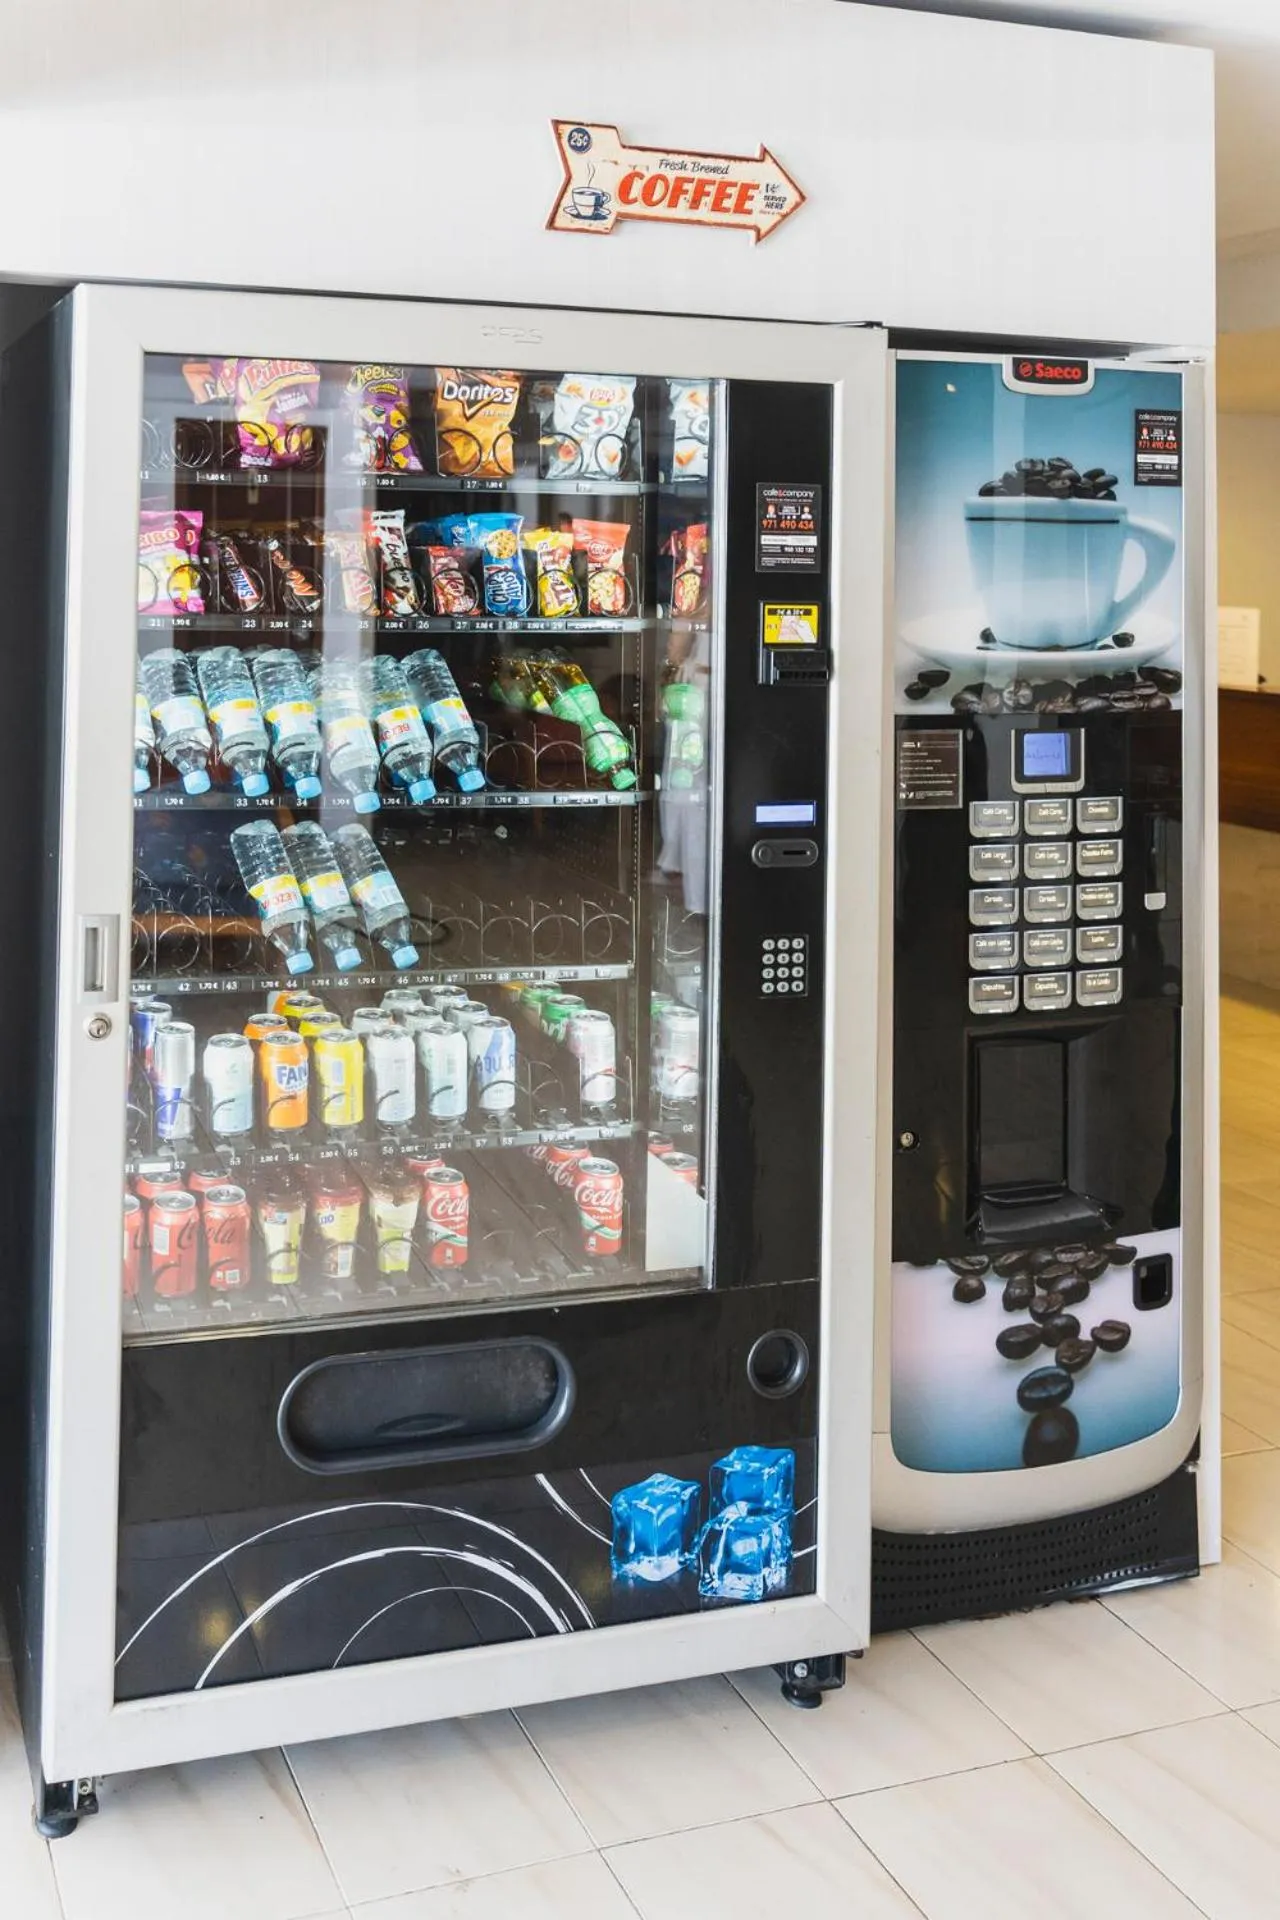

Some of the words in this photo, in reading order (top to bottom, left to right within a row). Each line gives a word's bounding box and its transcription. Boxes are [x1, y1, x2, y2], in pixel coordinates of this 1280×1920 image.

[571, 131, 589, 146] 25¢
[658, 159, 688, 171] Fresh
[691, 161, 730, 175] Brewed
[618, 171, 760, 215] COFFEE
[1035, 361, 1082, 379] Saeco
[444, 380, 515, 404] Doritos
[762, 519, 777, 529] 971
[780, 520, 797, 530] 490
[245, 619, 256, 628] 23
[418, 620, 430, 629] 26
[455, 621, 467, 630] 27
[236, 798, 248, 807] 33
[296, 798, 307, 807] 34
[460, 796, 472, 805] 37
[226, 981, 238, 990] 43
[286, 979, 297, 988] 44
[337, 977, 349, 986] 45
[178, 983, 191, 992] 42
[276, 1060, 308, 1085] FAN
